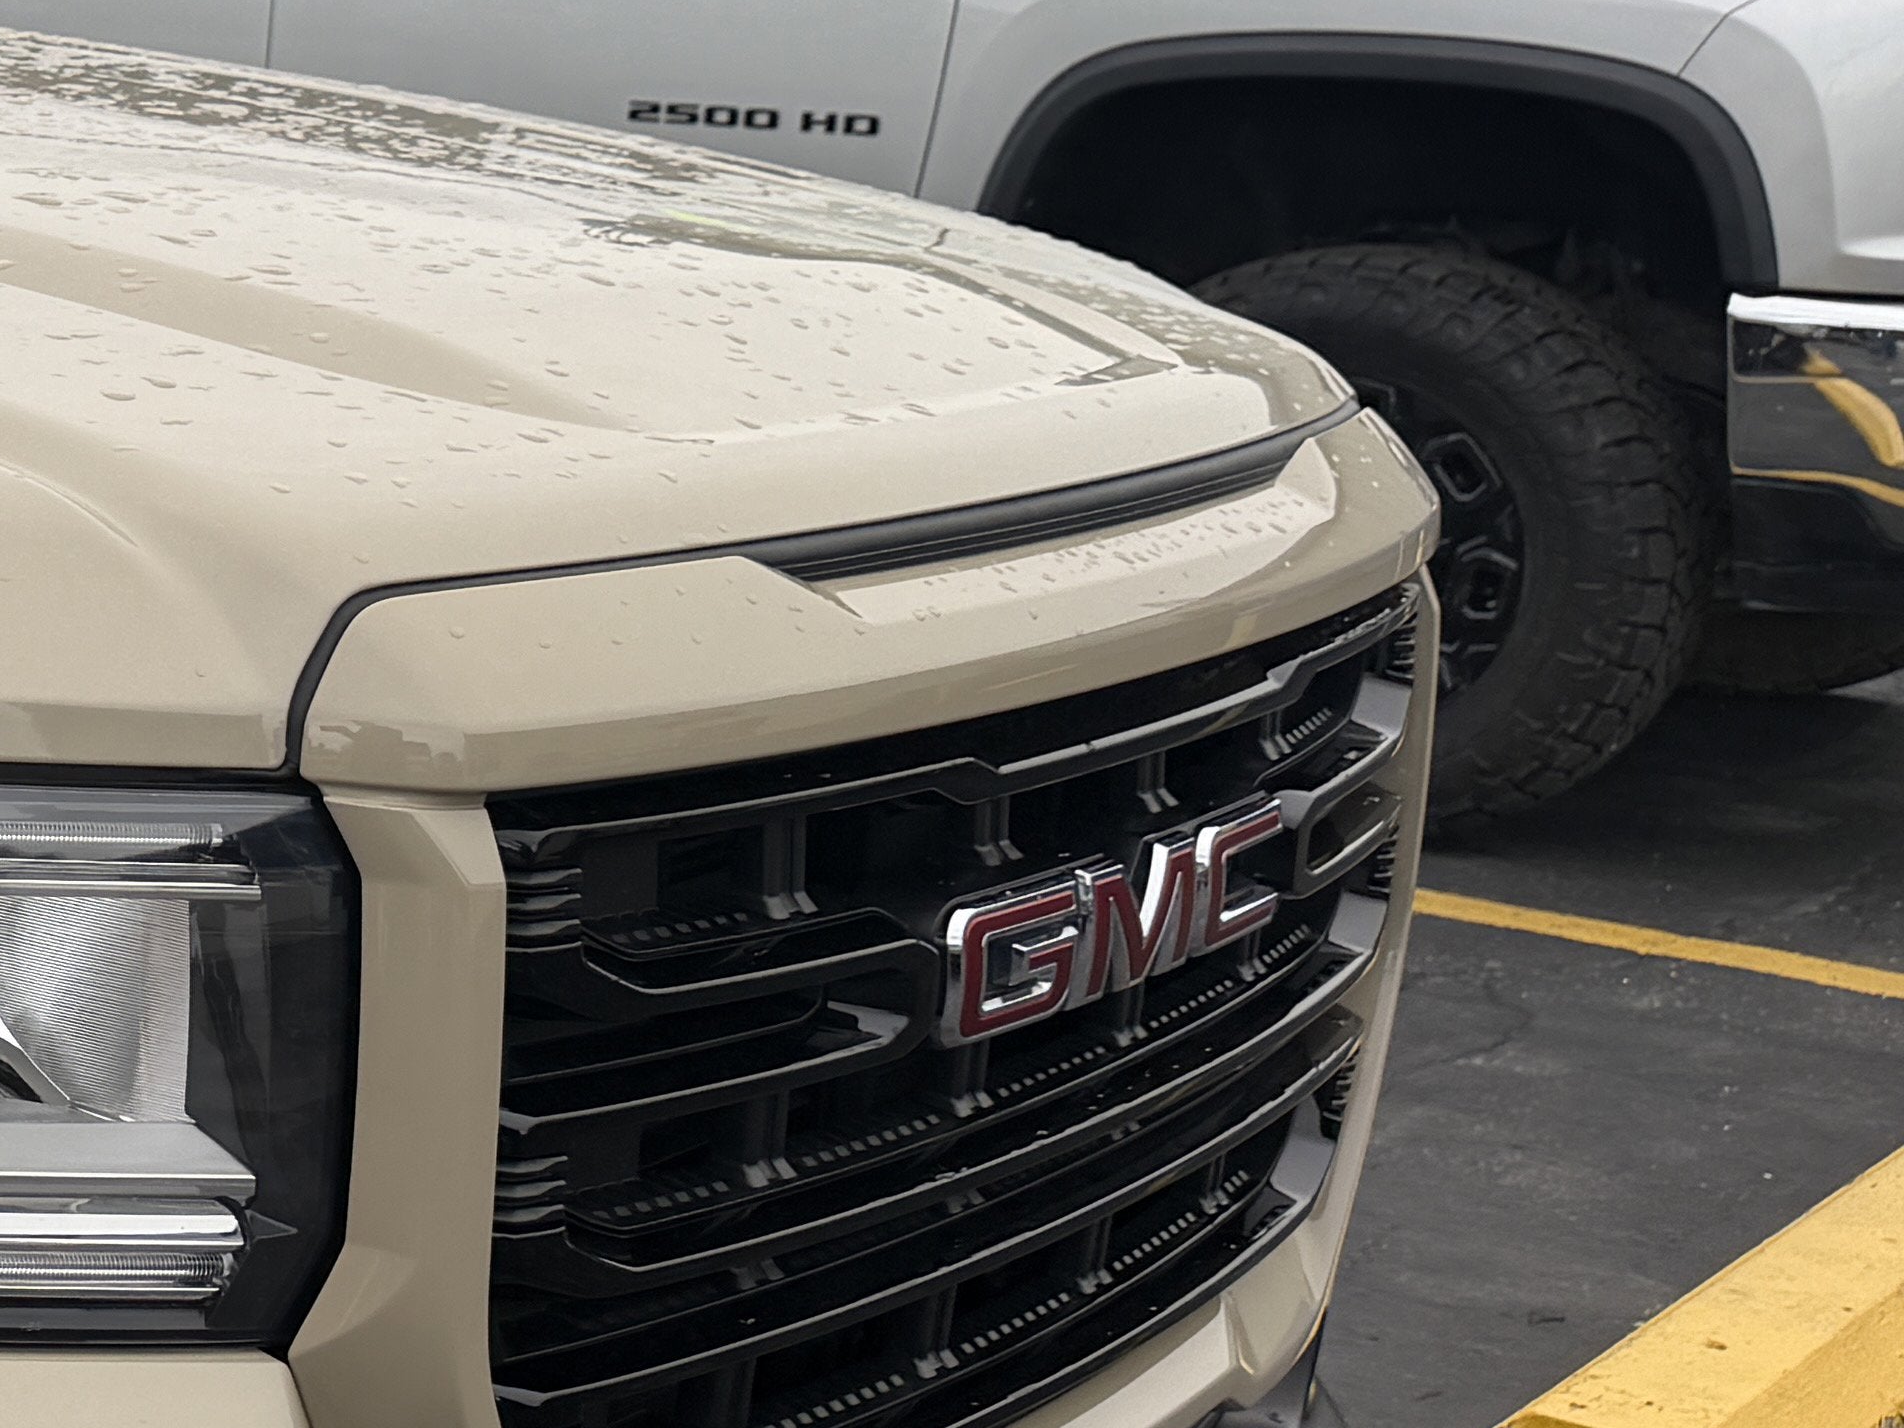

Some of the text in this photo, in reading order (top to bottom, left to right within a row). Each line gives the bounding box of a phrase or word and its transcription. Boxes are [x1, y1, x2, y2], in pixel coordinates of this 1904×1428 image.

[626, 99, 880, 136] 2500 HD
[942, 798, 1285, 1050] GMC
